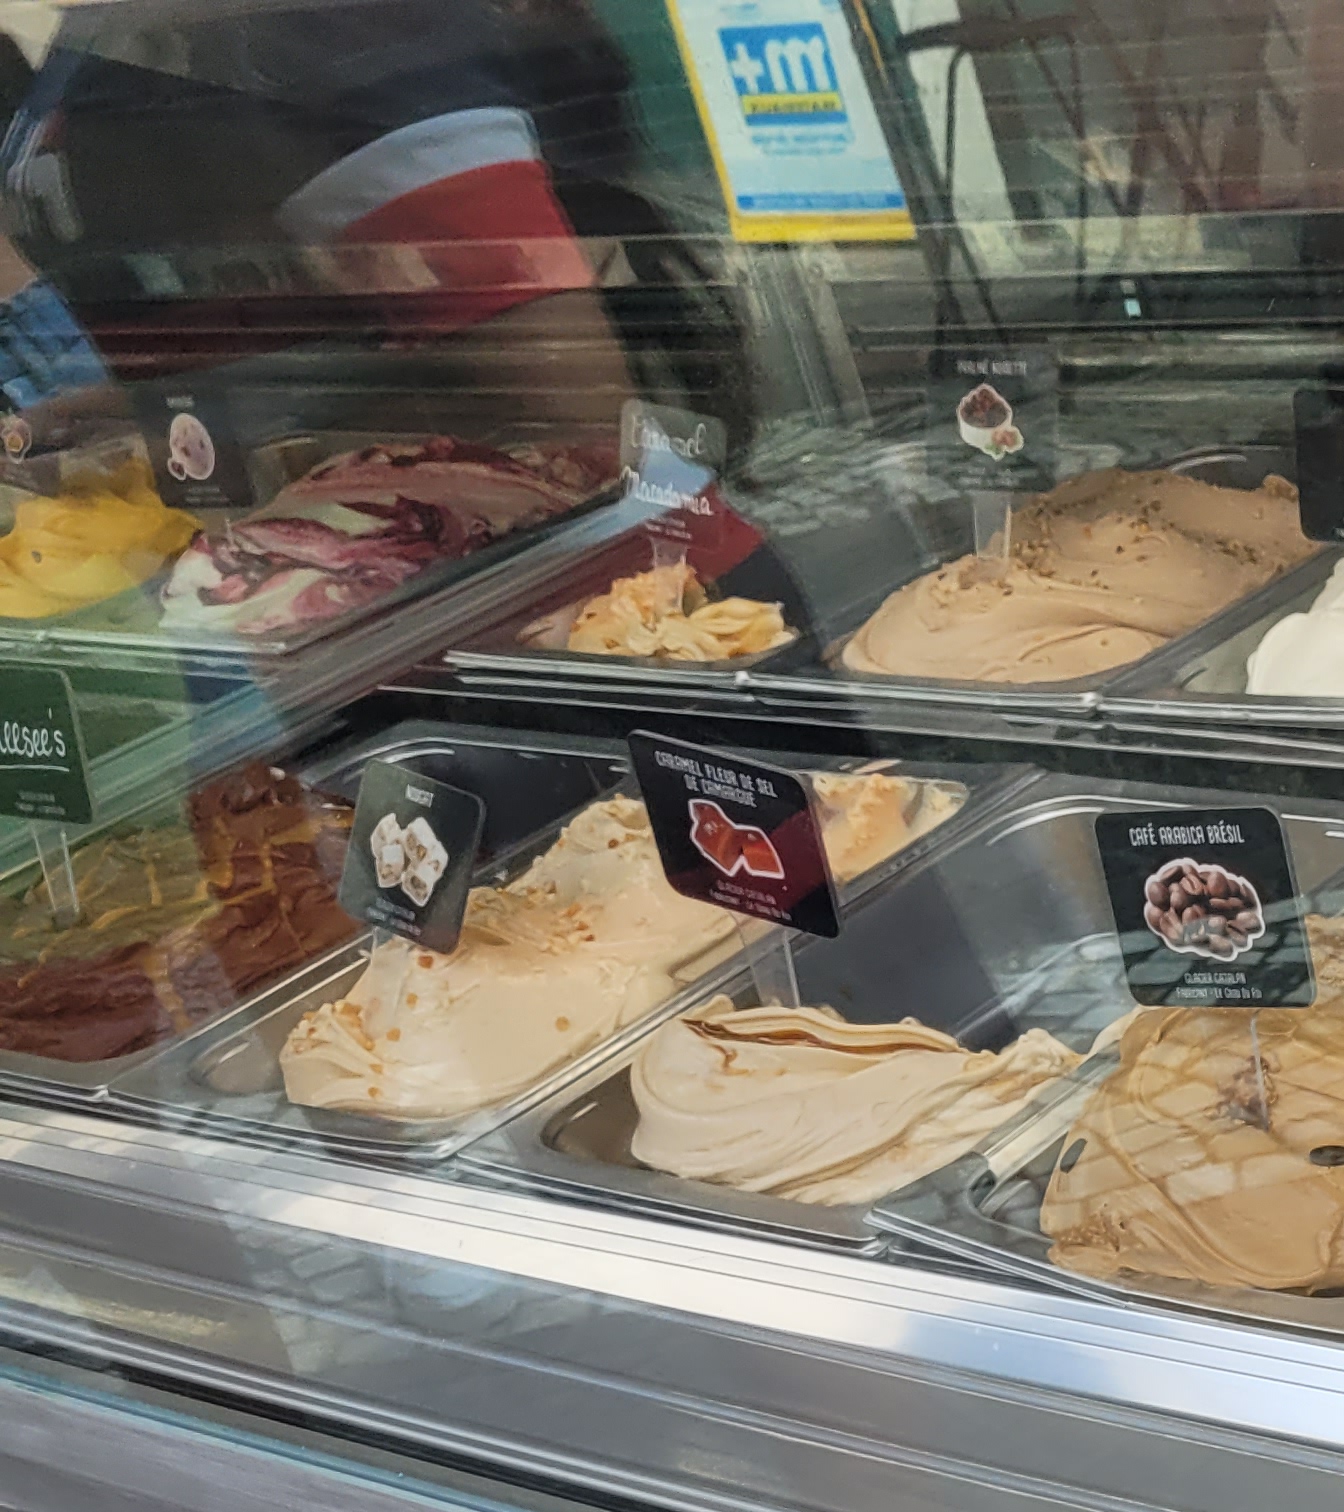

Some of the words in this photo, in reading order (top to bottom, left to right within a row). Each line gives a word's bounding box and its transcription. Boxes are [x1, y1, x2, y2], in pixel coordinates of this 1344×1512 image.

[1128, 822, 1158, 847] CAFÉ
[1158, 824, 1206, 846] ARABICA
[1206, 819, 1246, 845] BRÉSIL
